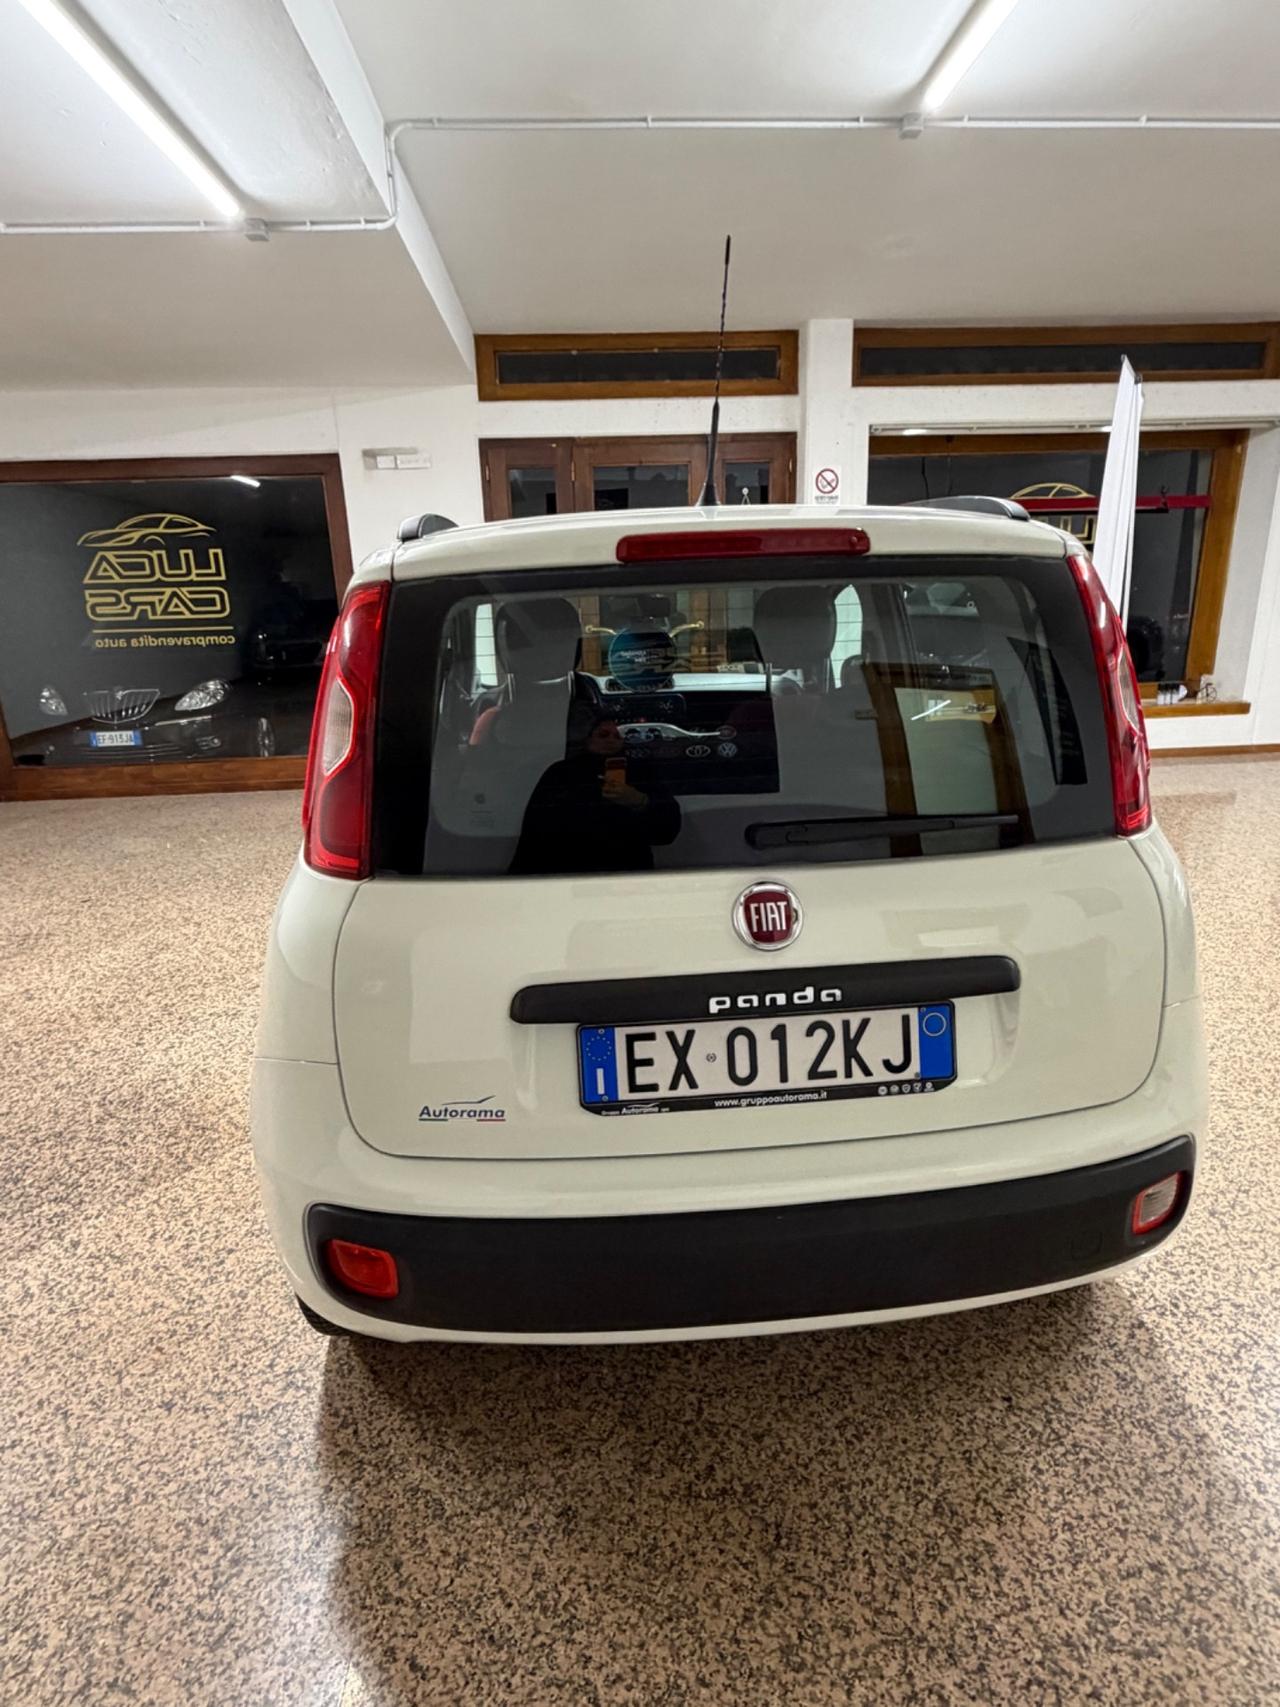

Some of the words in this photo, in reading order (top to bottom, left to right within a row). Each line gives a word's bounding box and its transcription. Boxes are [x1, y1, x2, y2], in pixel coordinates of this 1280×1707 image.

[750, 901, 788, 932] FIAT
[709, 986, 843, 1013] panda
[625, 1029, 699, 1094] EX
[419, 1105, 505, 1118] Autorama
[714, 1091, 827, 1107] www.gruppoautorama.it
